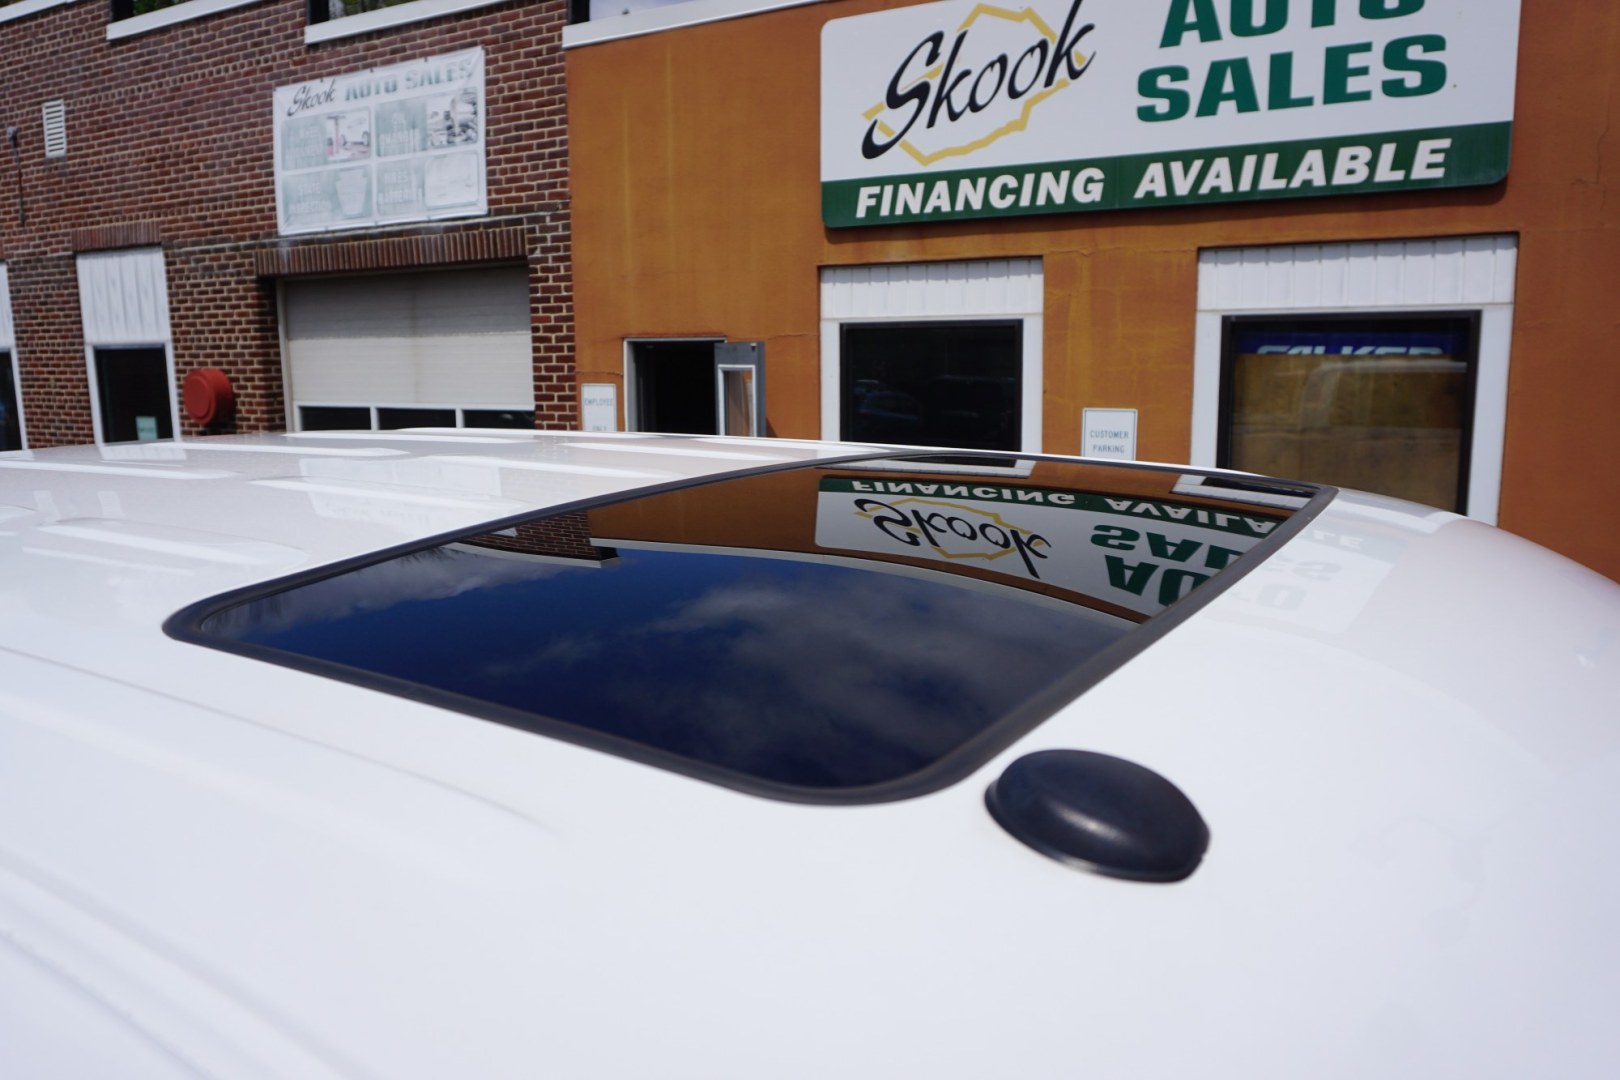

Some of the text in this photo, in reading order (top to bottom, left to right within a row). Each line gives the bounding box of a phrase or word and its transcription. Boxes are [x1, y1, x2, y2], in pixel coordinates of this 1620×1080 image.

[286, 60, 474, 117] Skook AUTO SALES
[861, 0, 1096, 159] Skook
[1136, 33, 1447, 123] SALES
[855, 138, 1453, 219] FINANCING AVAILABLE
[1089, 429, 1130, 439] CUSTOMER
[1092, 443, 1125, 454] PARKING
